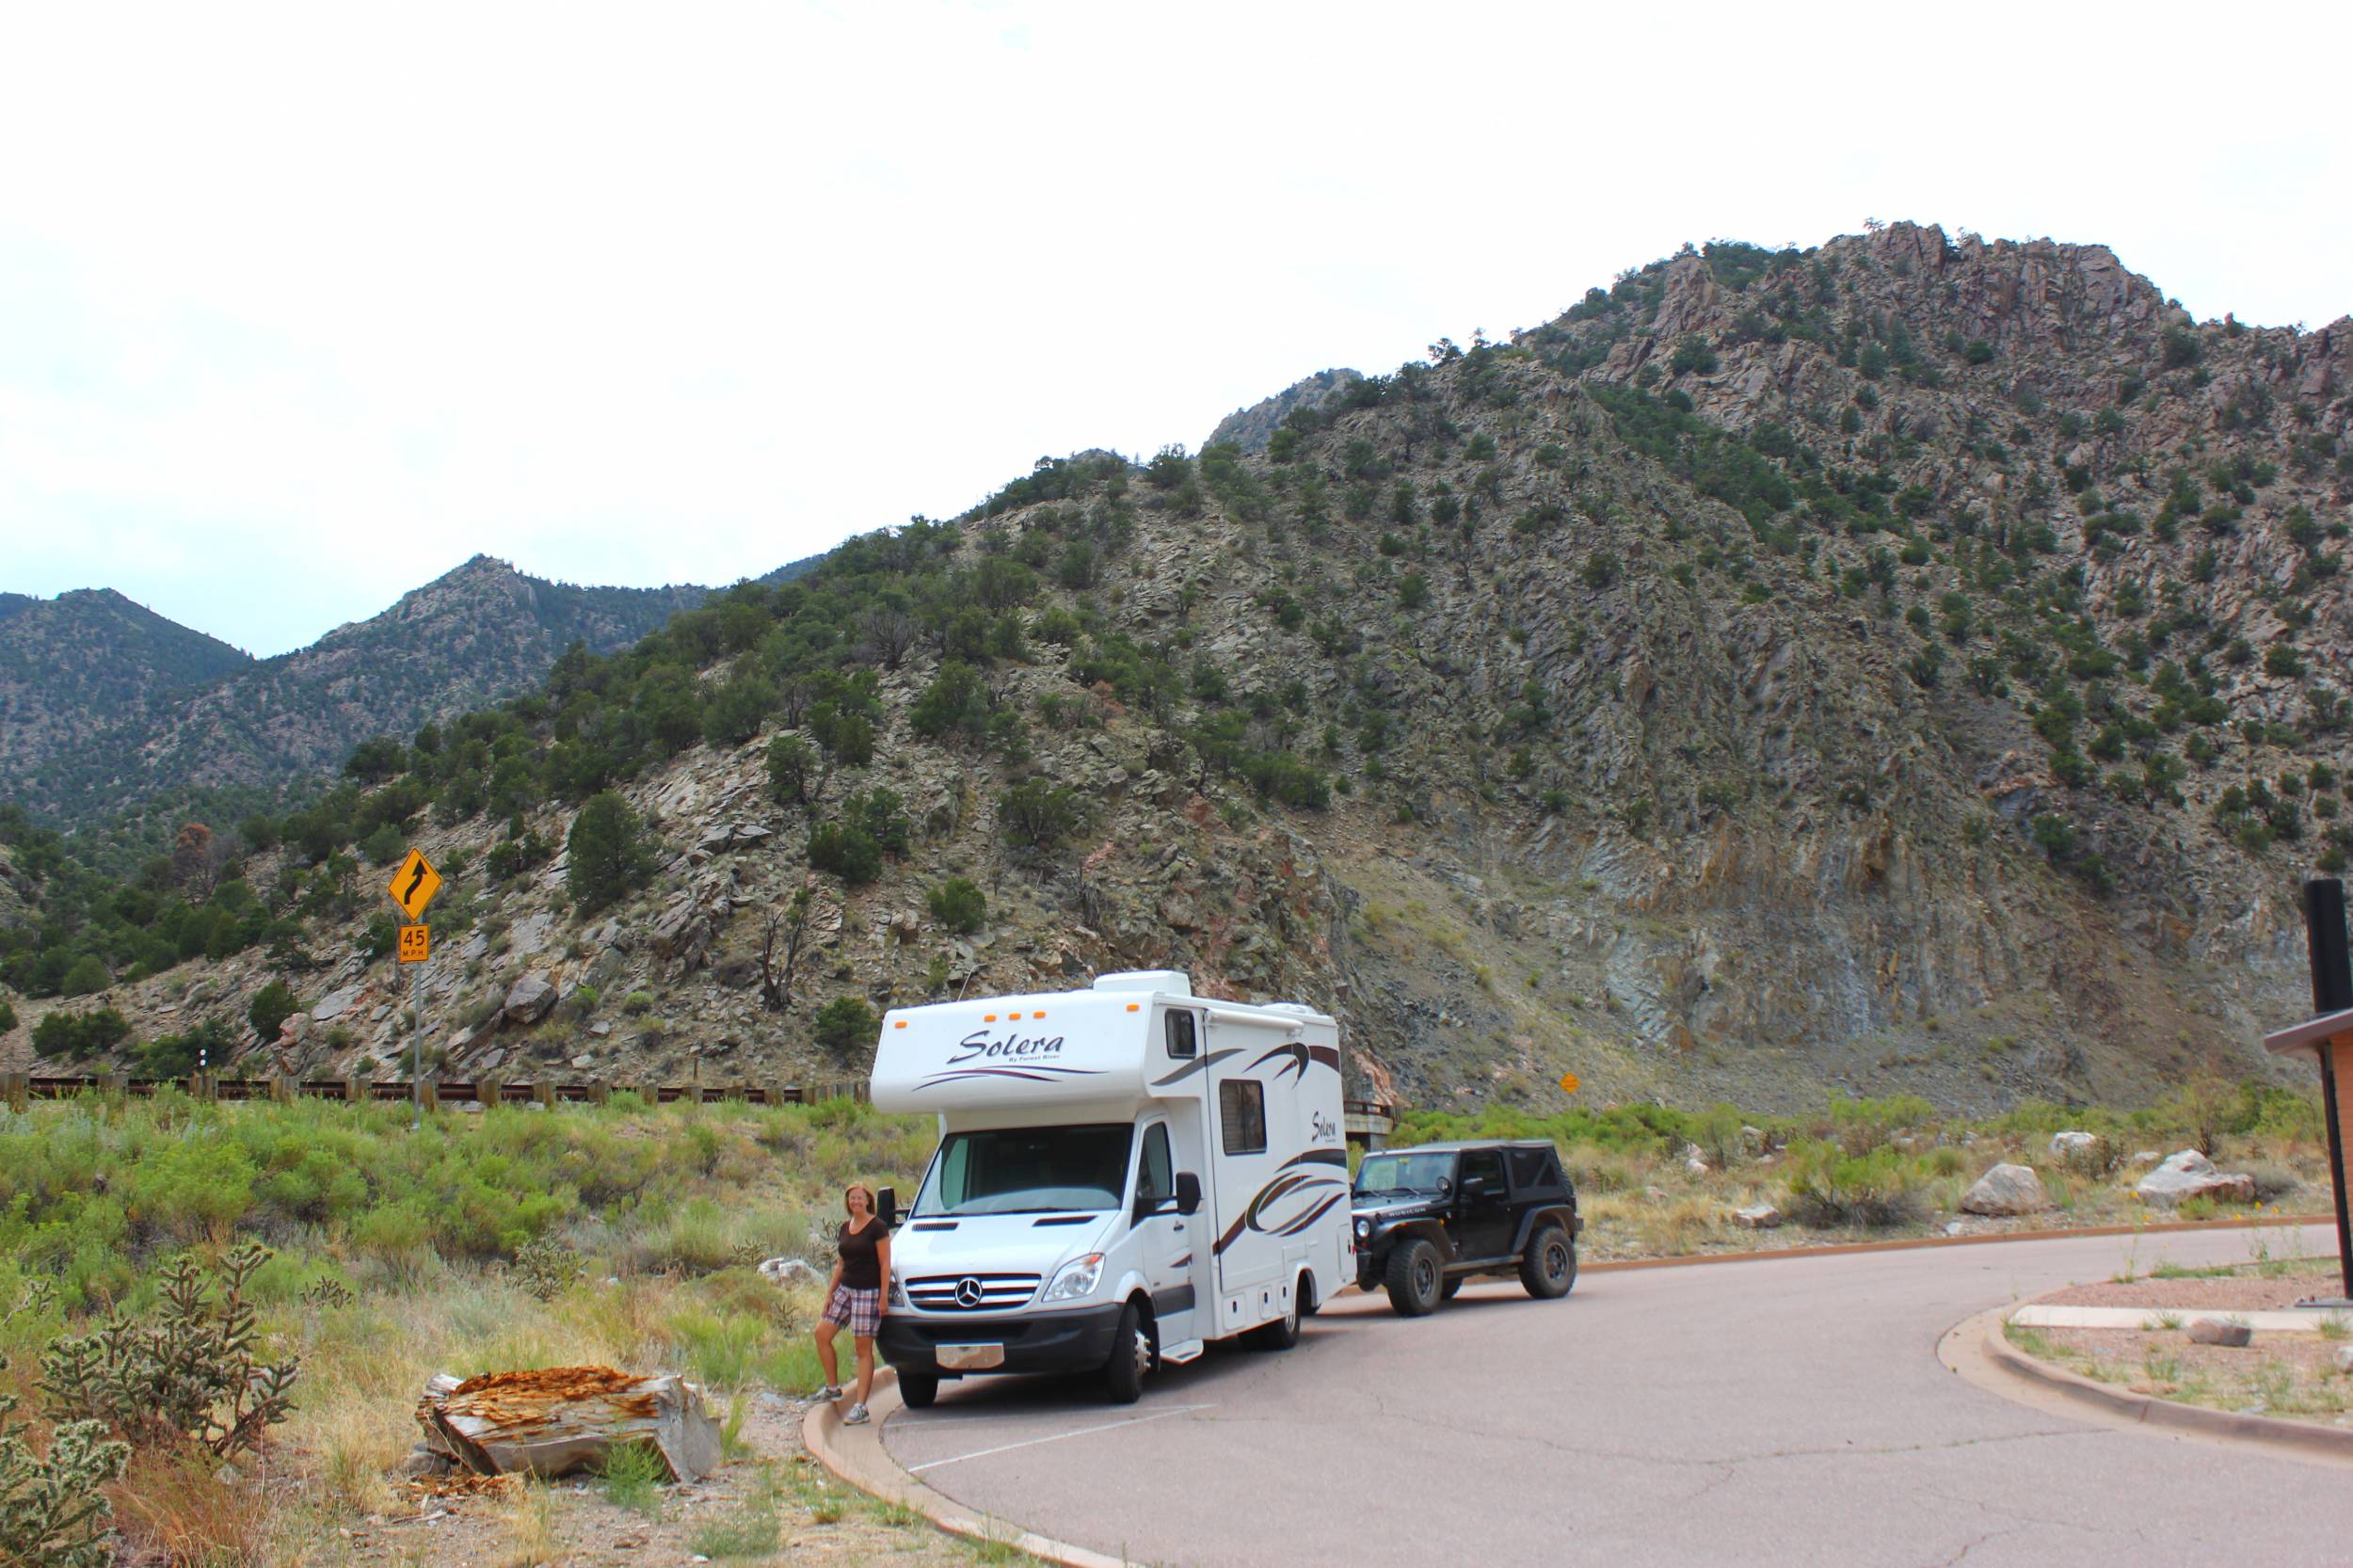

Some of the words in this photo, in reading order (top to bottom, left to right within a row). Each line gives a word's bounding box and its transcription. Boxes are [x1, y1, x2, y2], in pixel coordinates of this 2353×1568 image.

[404, 930, 425, 946] 45
[946, 1030, 1064, 1064] Solera
[1311, 1111, 1336, 1142] Solera
[1388, 1207, 1427, 1218] RUBICON
